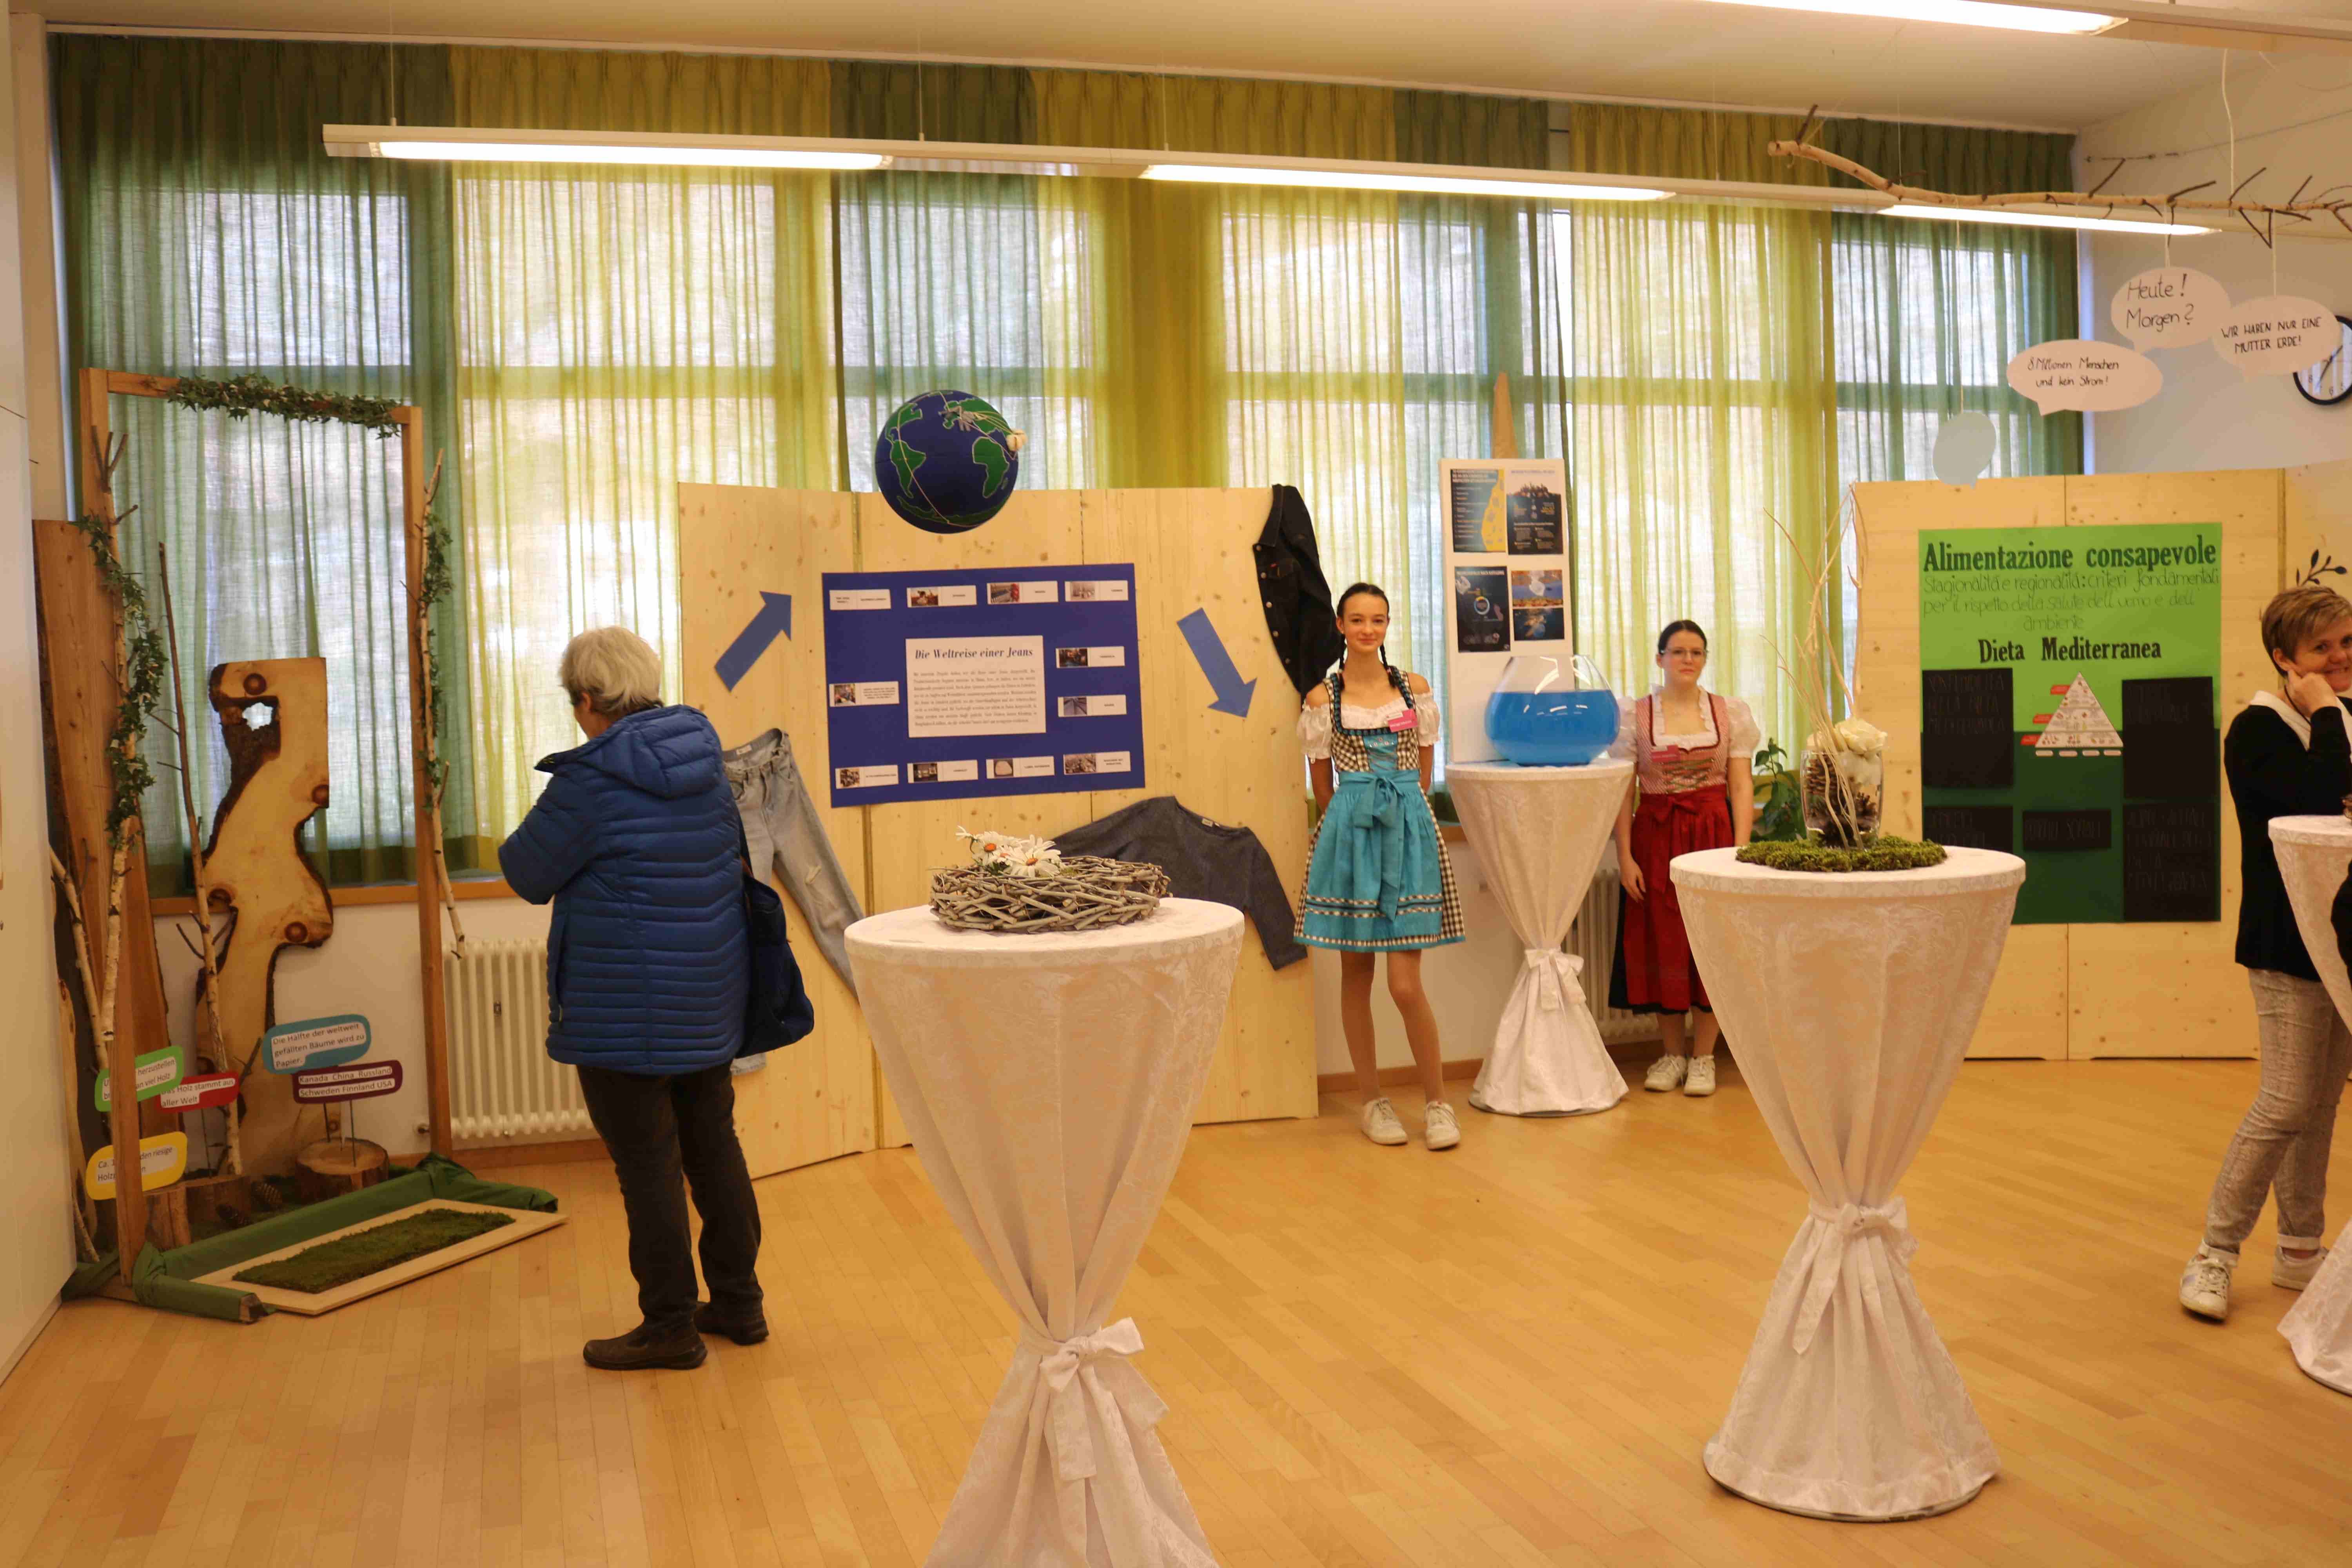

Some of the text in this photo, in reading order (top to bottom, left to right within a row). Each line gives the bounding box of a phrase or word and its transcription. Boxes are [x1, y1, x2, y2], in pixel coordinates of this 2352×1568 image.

[2221, 316, 2322, 338] WIR HABEN NUR EINE
[2235, 335, 2301, 354] MUTTER ERDE!
[2079, 356, 2119, 370] Menschen
[2036, 376, 2053, 387] und
[2059, 376, 2074, 386] kein
[1923, 534, 2216, 572] Alimentazione consapevole
[2088, 569, 2127, 589] criteri
[2133, 568, 2219, 592] fondamentali
[1923, 600, 1945, 618] per
[1965, 596, 2007, 617] rispetto
[2011, 593, 2044, 612] della
[2023, 614, 2085, 633] ambiente
[915, 646, 1033, 659] Die Weltreise einer Jeans
[1978, 636, 2162, 664] Dieta Mediterranea
[288, 1033, 310, 1042] Hälfte
[327, 1024, 359, 1034] weltweit
[275, 1044, 308, 1058] gefällten
[309, 1039, 336, 1049] Bäume
[338, 1035, 354, 1044] wird
[138, 1059, 175, 1076] herzustellen
[276, 1058, 303, 1068] Papier.
[145, 1078, 156, 1086] viel
[157, 1073, 170, 1081] Holz
[299, 1074, 328, 1083] Kanada
[358, 1067, 392, 1077] Russland
[177, 1084, 192, 1093] Holz
[194, 1081, 221, 1091] stammt
[300, 1080, 392, 1097] Schweden Finnland USA
[162, 1096, 198, 1107] aller Welt
